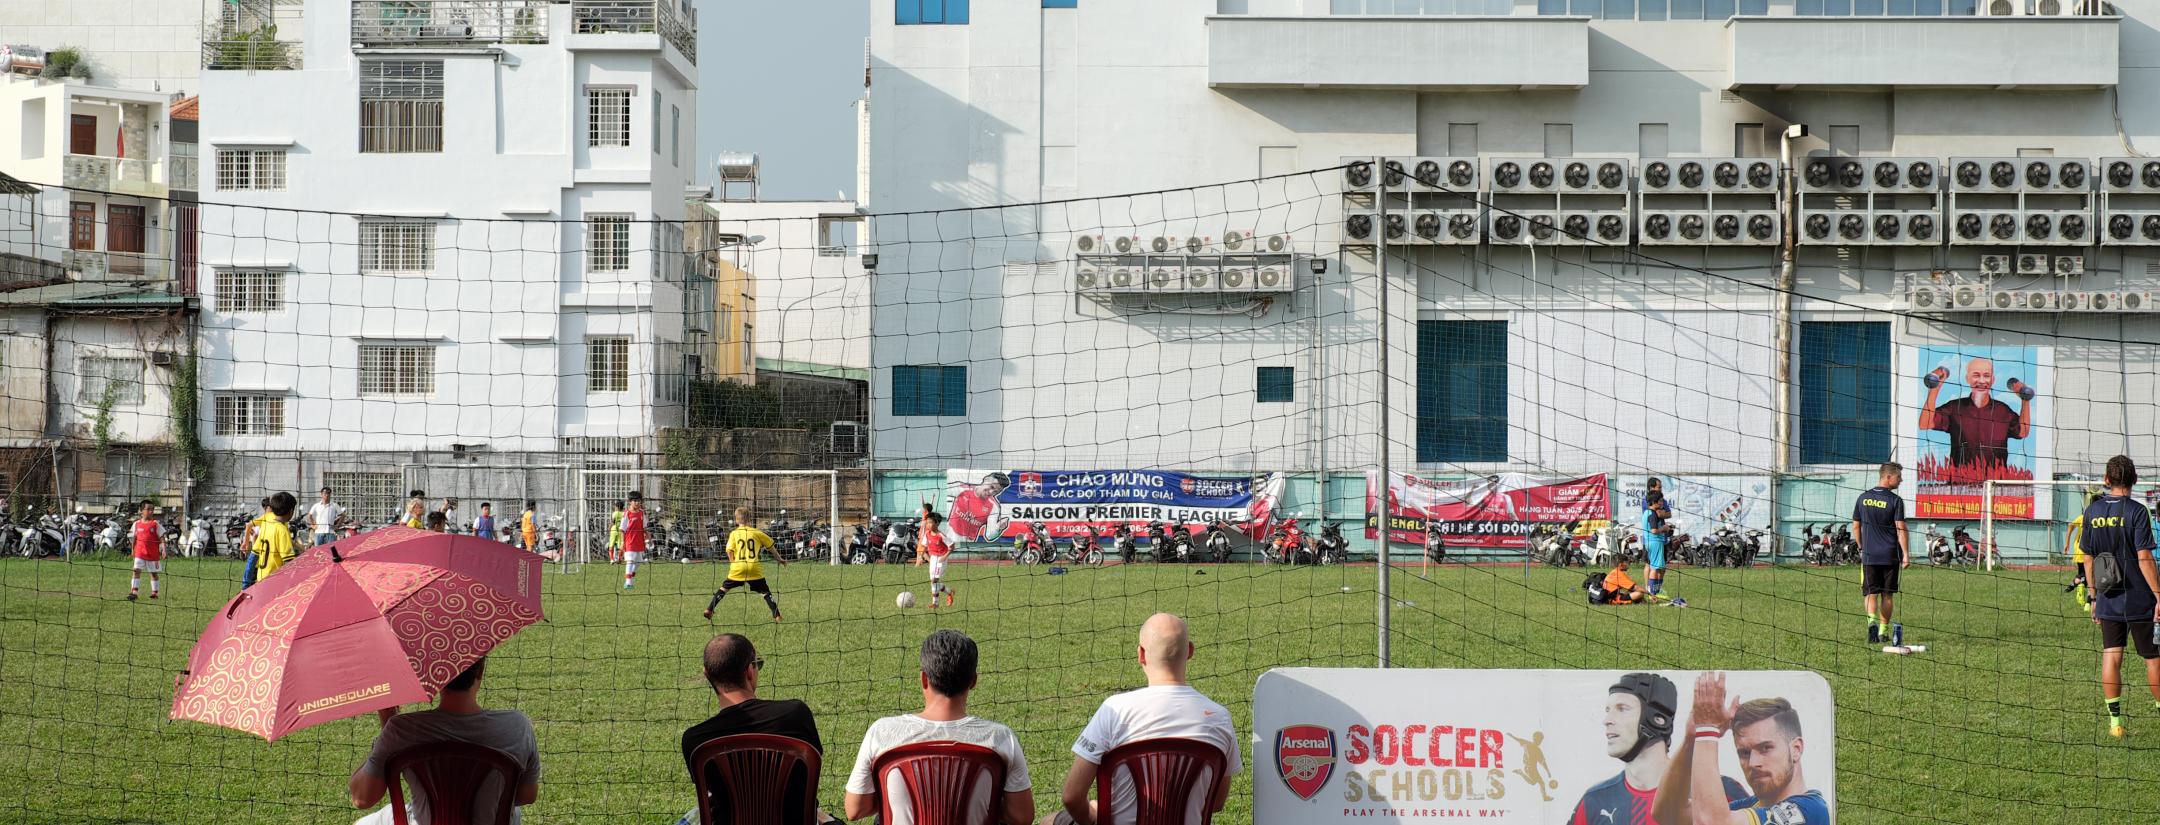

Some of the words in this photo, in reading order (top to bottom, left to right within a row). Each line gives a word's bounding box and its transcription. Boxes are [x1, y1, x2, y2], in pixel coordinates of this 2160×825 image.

[1056, 472, 1106, 486] CHÀO
[1112, 470, 1164, 487] MỪNG
[1196, 480, 1233, 489] SOCCER
[1051, 488, 1074, 498] CÁC
[1100, 489, 1129, 499] THAM
[1133, 489, 1149, 500] DỰ
[1558, 486, 1579, 496] GIẢM
[1862, 498, 1887, 509] COACH
[1012, 506, 1080, 519] SAIGON
[1086, 506, 1162, 520] PREMIER
[1168, 508, 1238, 523] LEAGUE
[1369, 516, 1423, 530] AENAL
[1478, 520, 1498, 533] SÔI
[737, 538, 756, 560] 29
[298, 682, 391, 713] UNIONSQUARE
[1282, 736, 1329, 749] Arsenal
[1344, 724, 1504, 769] SOCCER
[1344, 768, 1505, 802] SCHOOLS
[1344, 808, 1375, 817] PLAY
[1382, 808, 1405, 817] THE
[1413, 808, 1471, 817] ARSENAL
[1478, 808, 1505, 817] WAY
